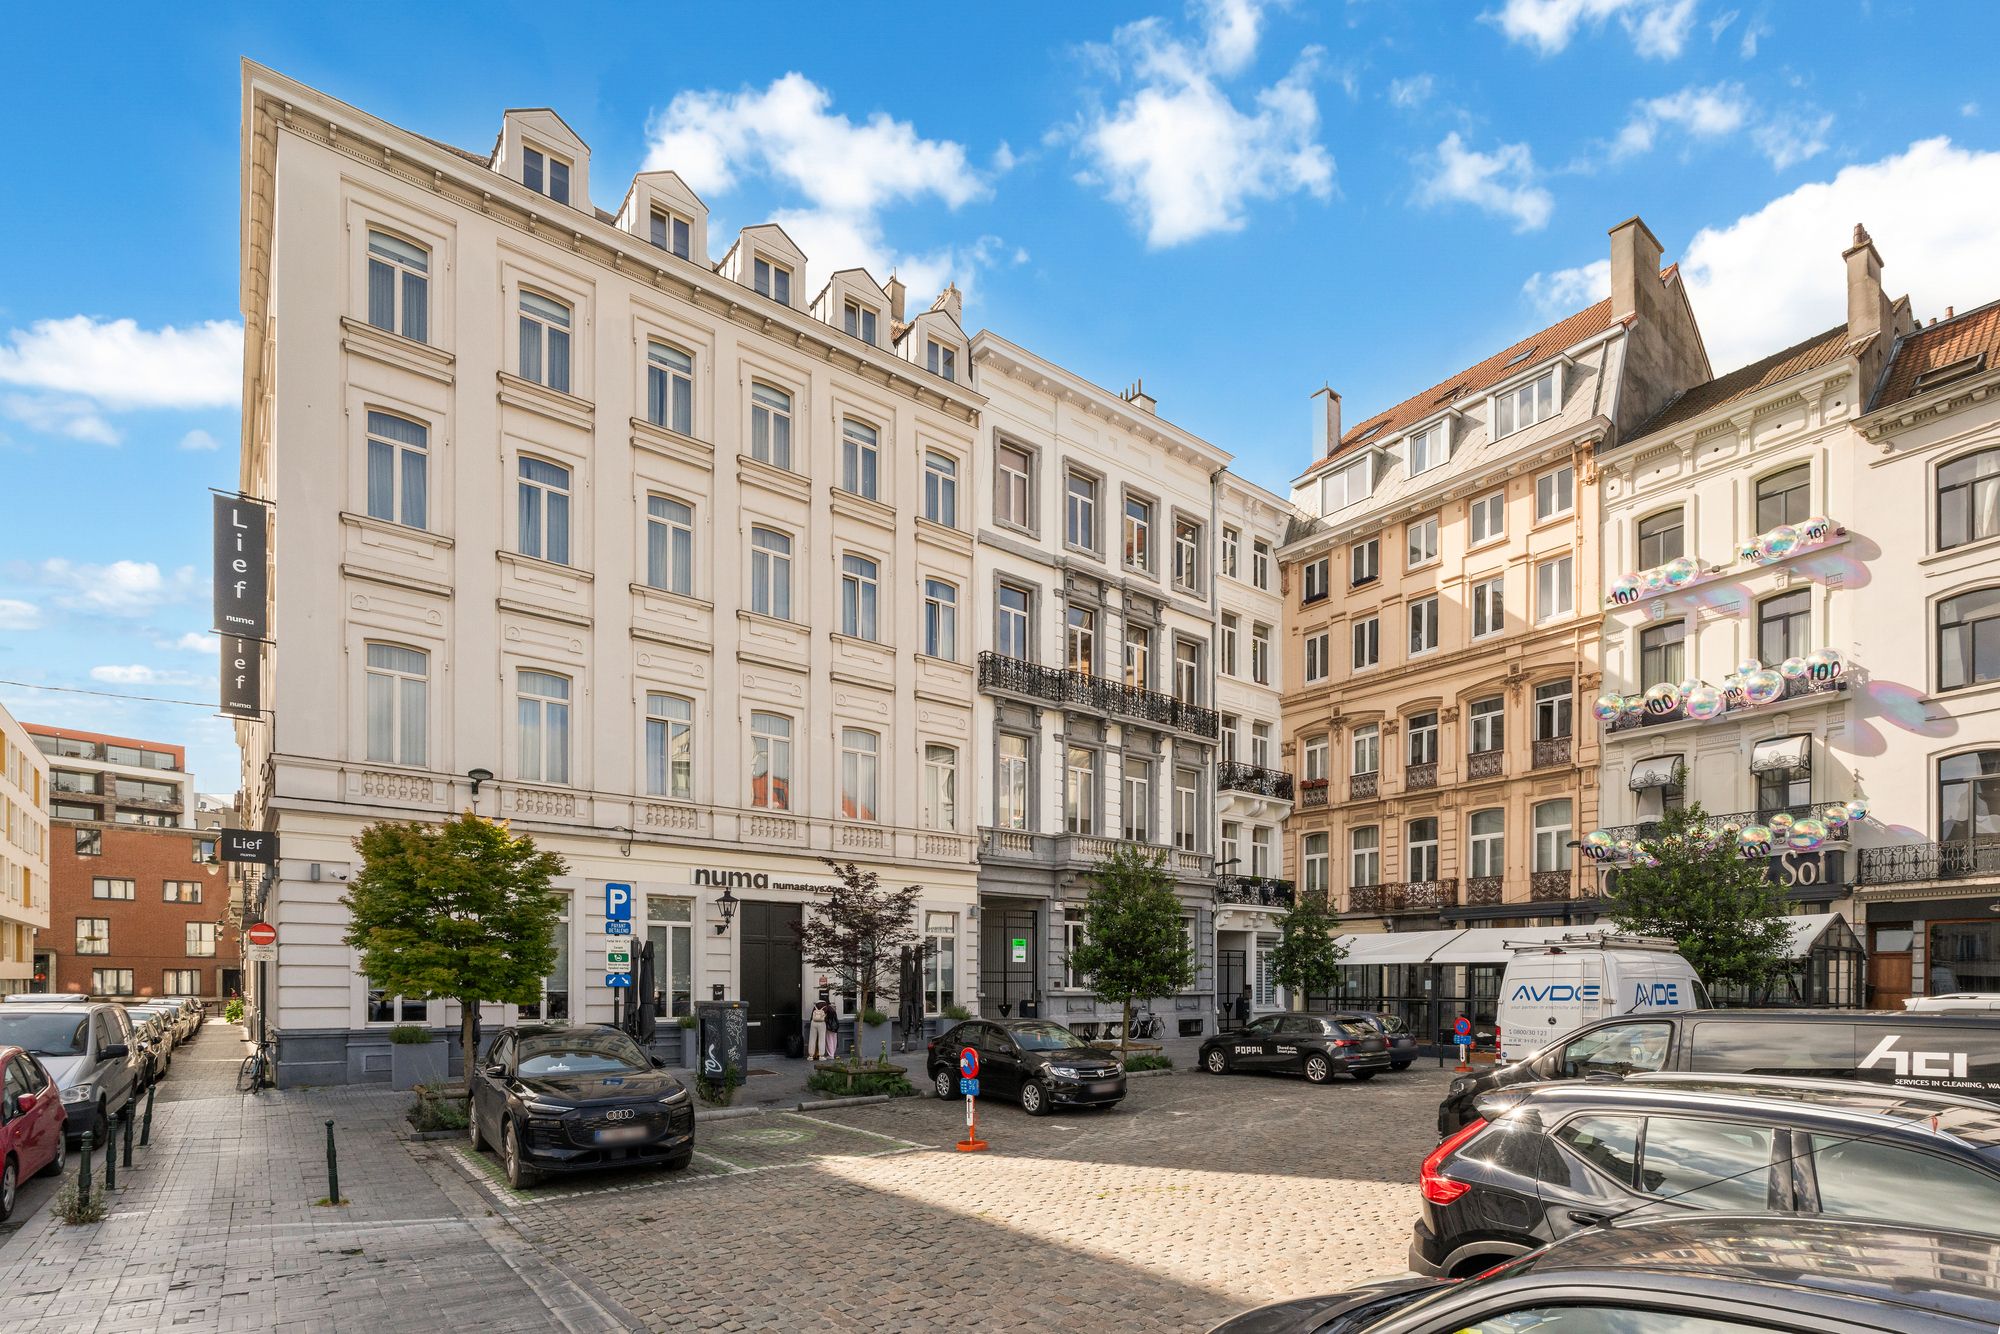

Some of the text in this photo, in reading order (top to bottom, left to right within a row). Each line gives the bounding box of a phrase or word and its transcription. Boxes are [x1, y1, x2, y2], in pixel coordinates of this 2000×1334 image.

[1807, 523, 1828, 539] 100
[232, 509, 248, 598] Lief
[1612, 587, 1639, 604] 100
[226, 615, 255, 625] numa
[234, 632, 246, 689] ief
[1806, 661, 1841, 680] 100
[1723, 687, 1743, 699] 100
[229, 701, 252, 709] numa
[1645, 694, 1674, 713] 100
[233, 838, 263, 850] Lief
[1780, 850, 1828, 887] Soi
[695, 868, 769, 889] numa
[610, 888, 628, 914] P
[1512, 985, 1600, 1001] AVDE
[1635, 983, 1679, 1006] AVDE
[1235, 1045, 1263, 1054] POPPY
[1895, 1079, 1929, 1087] SERVICES
[1941, 1080, 1985, 1089] CLEANING,
